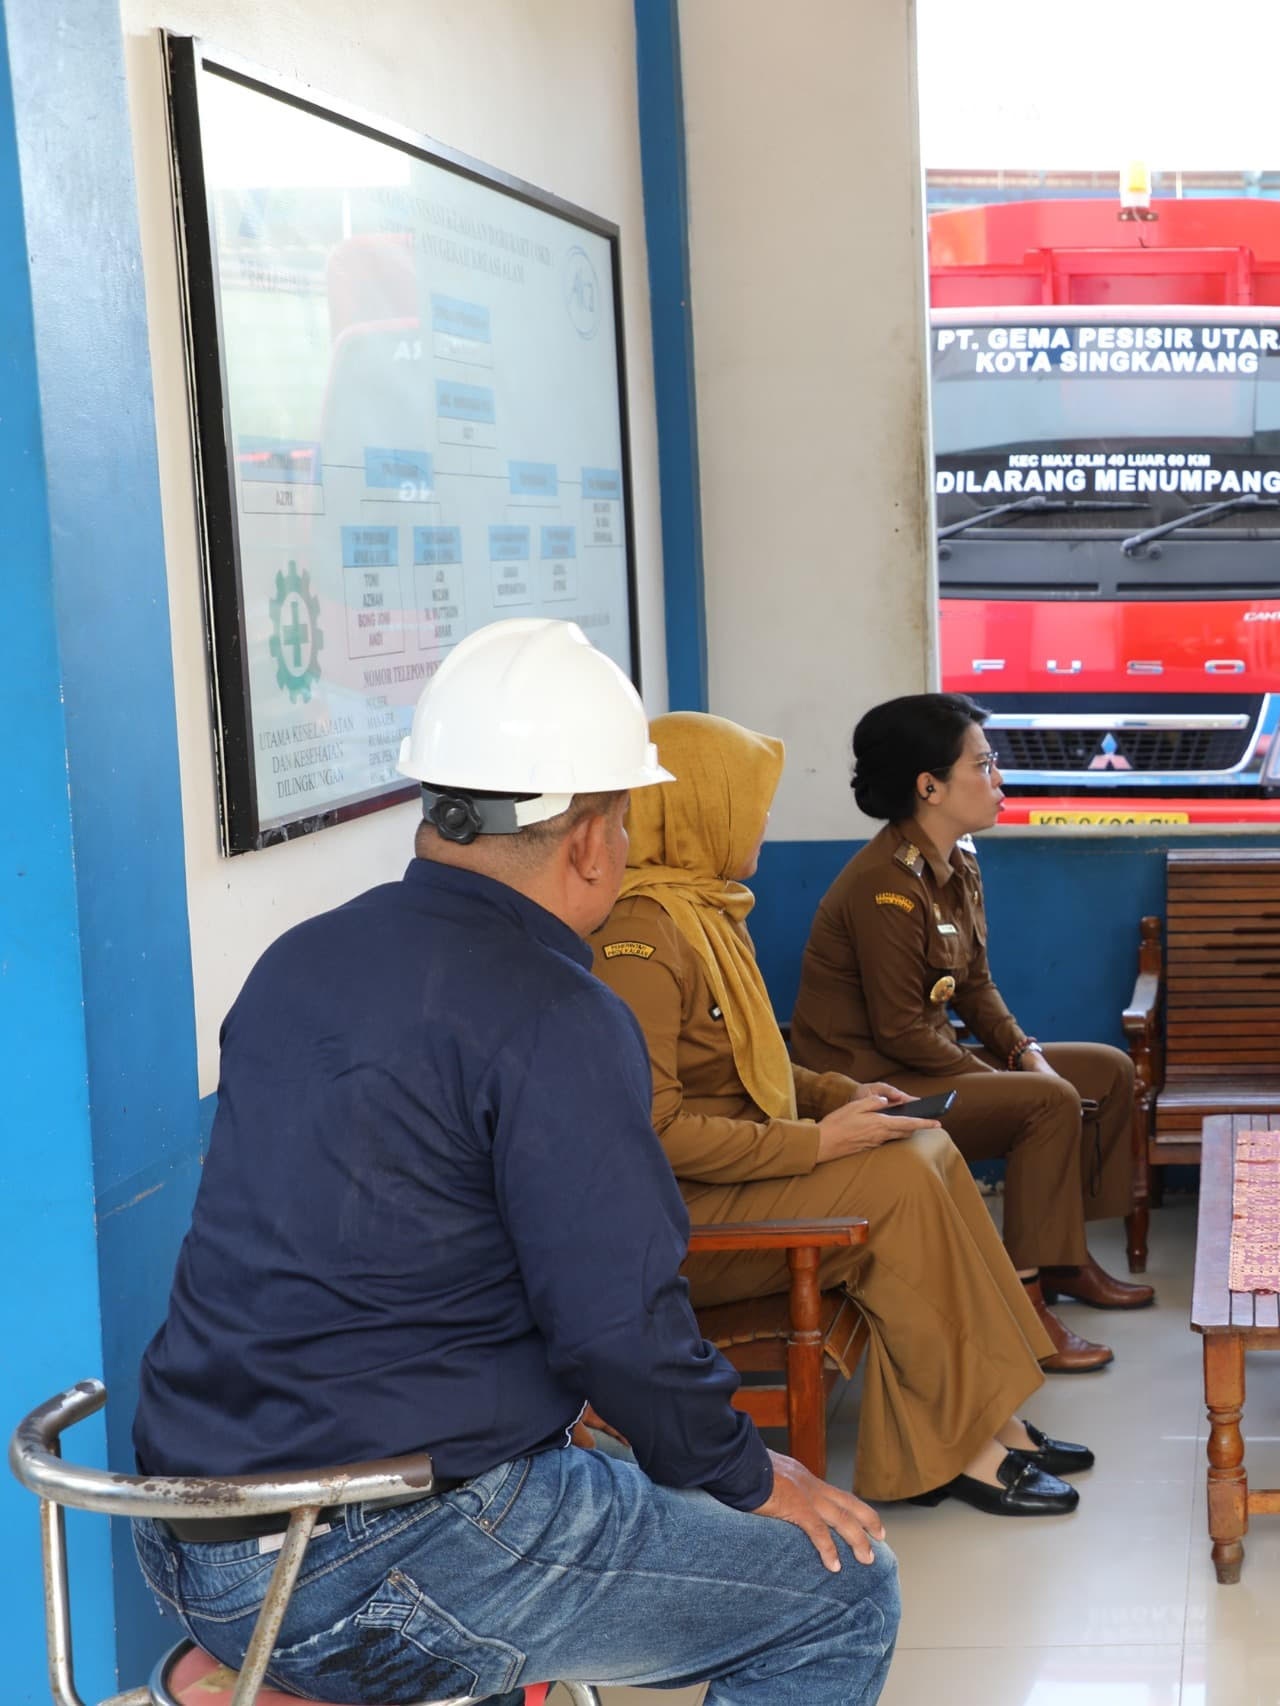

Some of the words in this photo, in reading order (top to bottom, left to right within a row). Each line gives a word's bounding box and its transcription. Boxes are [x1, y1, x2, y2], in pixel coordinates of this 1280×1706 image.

[937, 329, 979, 351] PT.
[987, 328, 1071, 350] GEMA
[1079, 328, 1193, 349] PESISIR
[976, 352, 1052, 373] KOTA
[1060, 351, 1258, 373] SINGKAWANG
[1009, 455, 1039, 467] KEC
[1041, 455, 1073, 467] MAX
[1075, 455, 1106, 467] DLM
[1107, 455, 1126, 467] 40
[1128, 455, 1166, 467] LUAR
[1187, 455, 1211, 467] KM
[936, 470, 1086, 493] DILARANG
[293, 742, 345, 770] KESEHATAN
